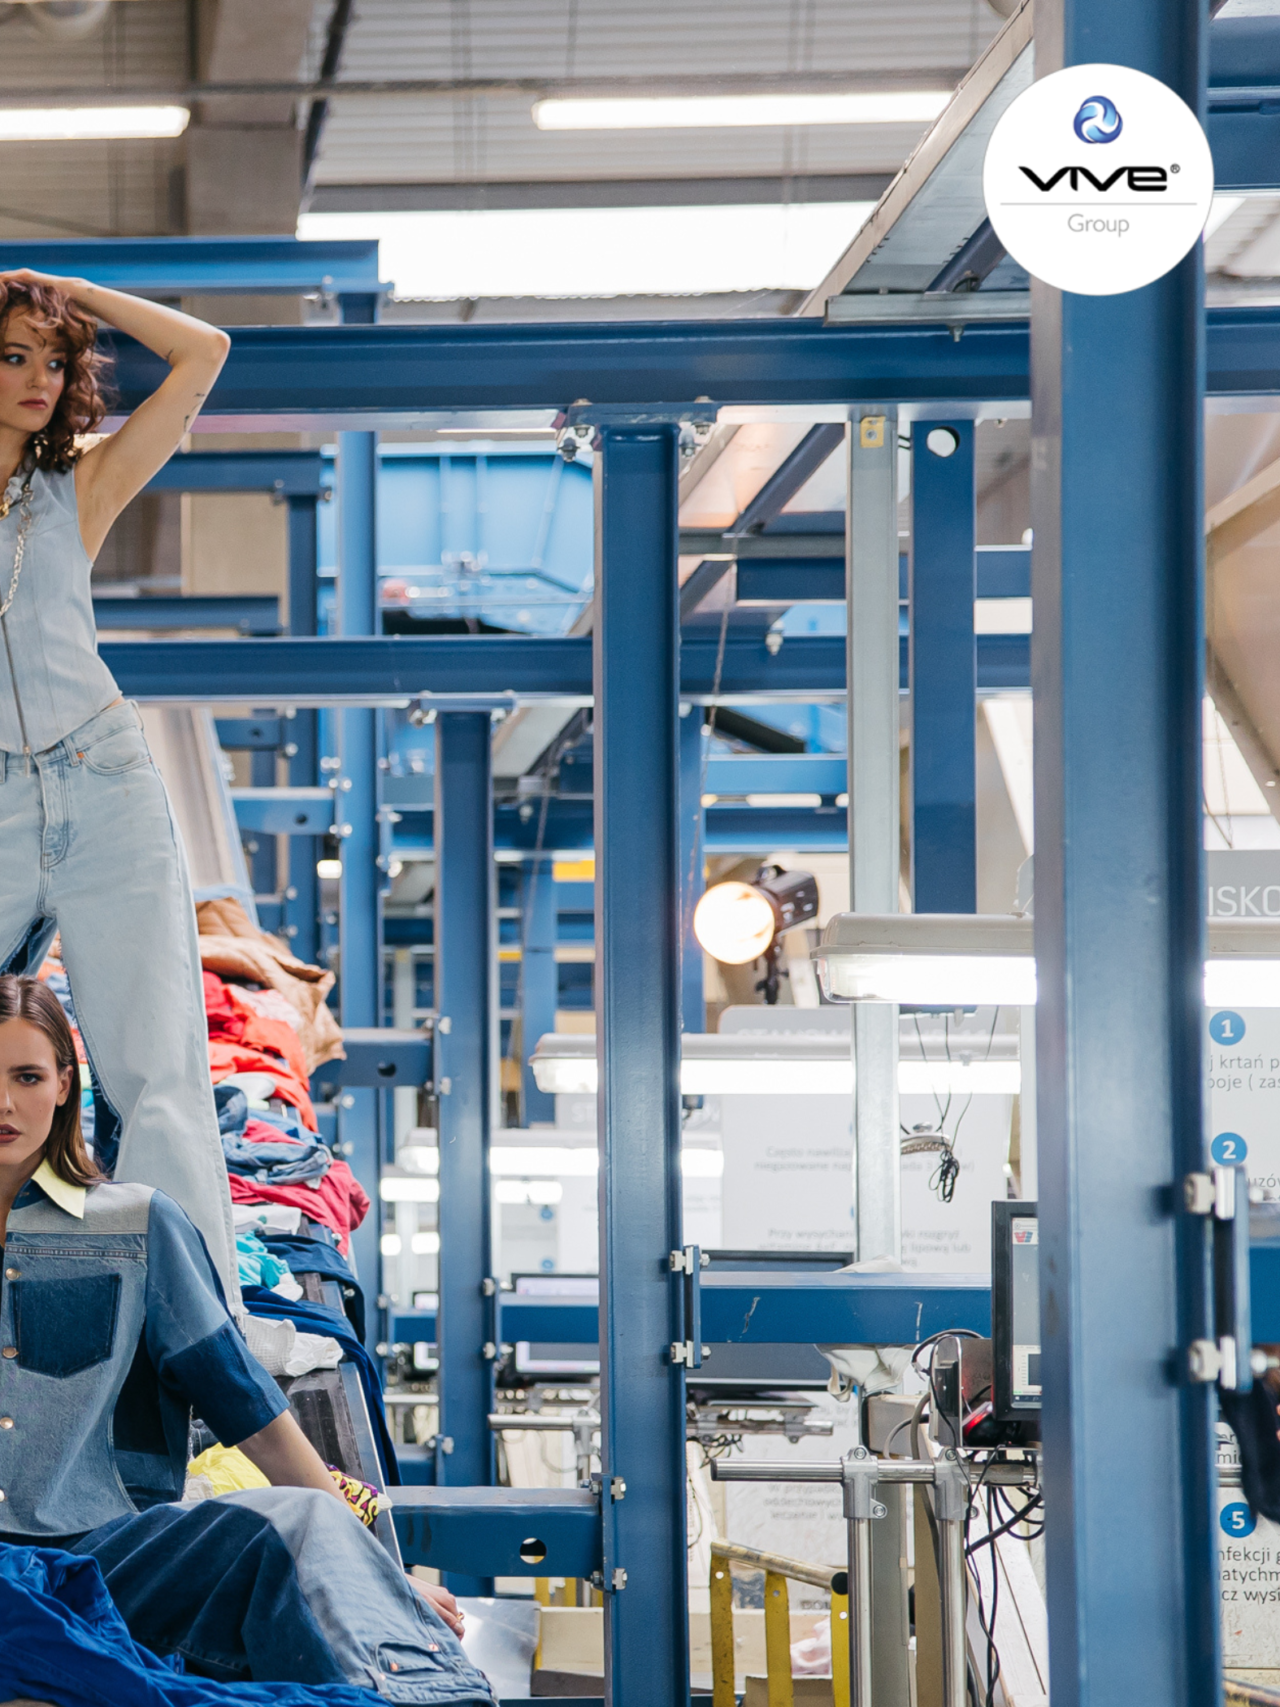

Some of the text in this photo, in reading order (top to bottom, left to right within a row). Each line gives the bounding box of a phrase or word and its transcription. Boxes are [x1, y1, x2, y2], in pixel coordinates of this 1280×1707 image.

[1221, 1019, 1234, 1038] 1
[1220, 1054, 1263, 1069] krtań
[1222, 1140, 1236, 1159] 2
[1231, 1511, 1245, 1530] 5
